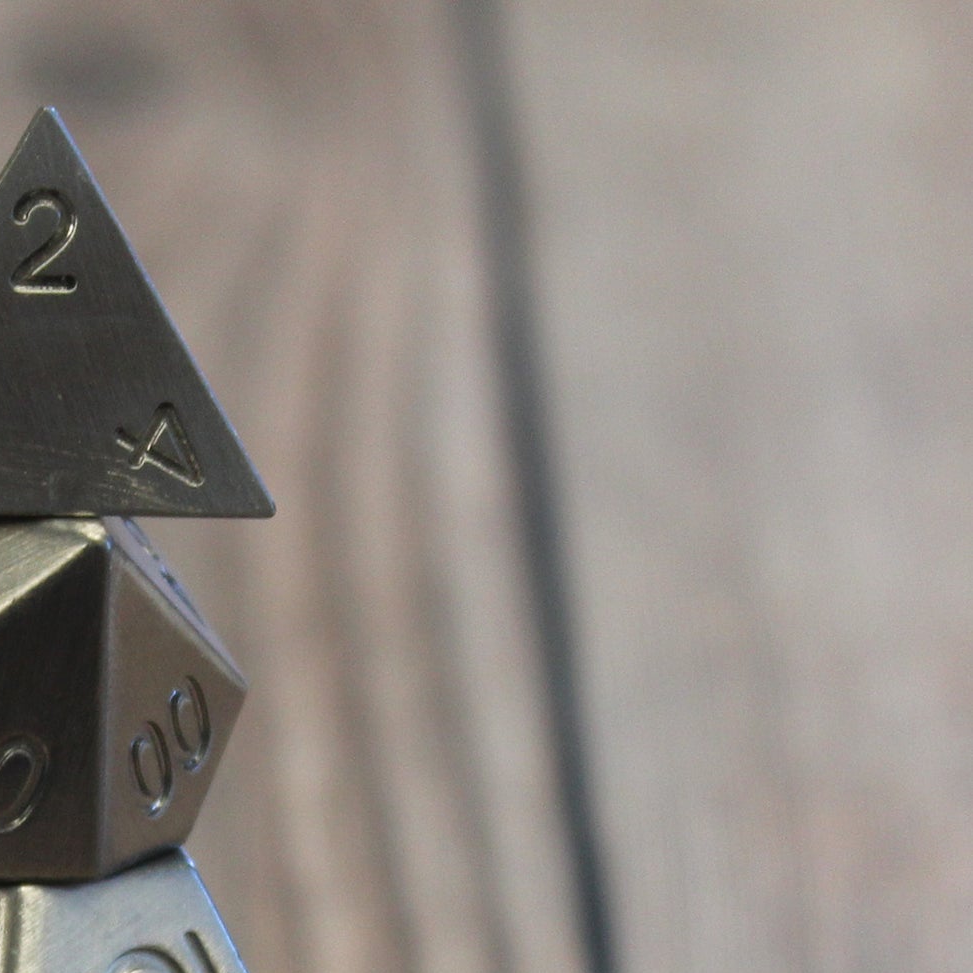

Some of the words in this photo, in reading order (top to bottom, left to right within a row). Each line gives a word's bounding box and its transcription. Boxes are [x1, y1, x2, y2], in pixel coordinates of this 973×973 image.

[10, 187, 78, 294] 2
[115, 401, 205, 488] 4
[131, 675, 212, 818] 00
